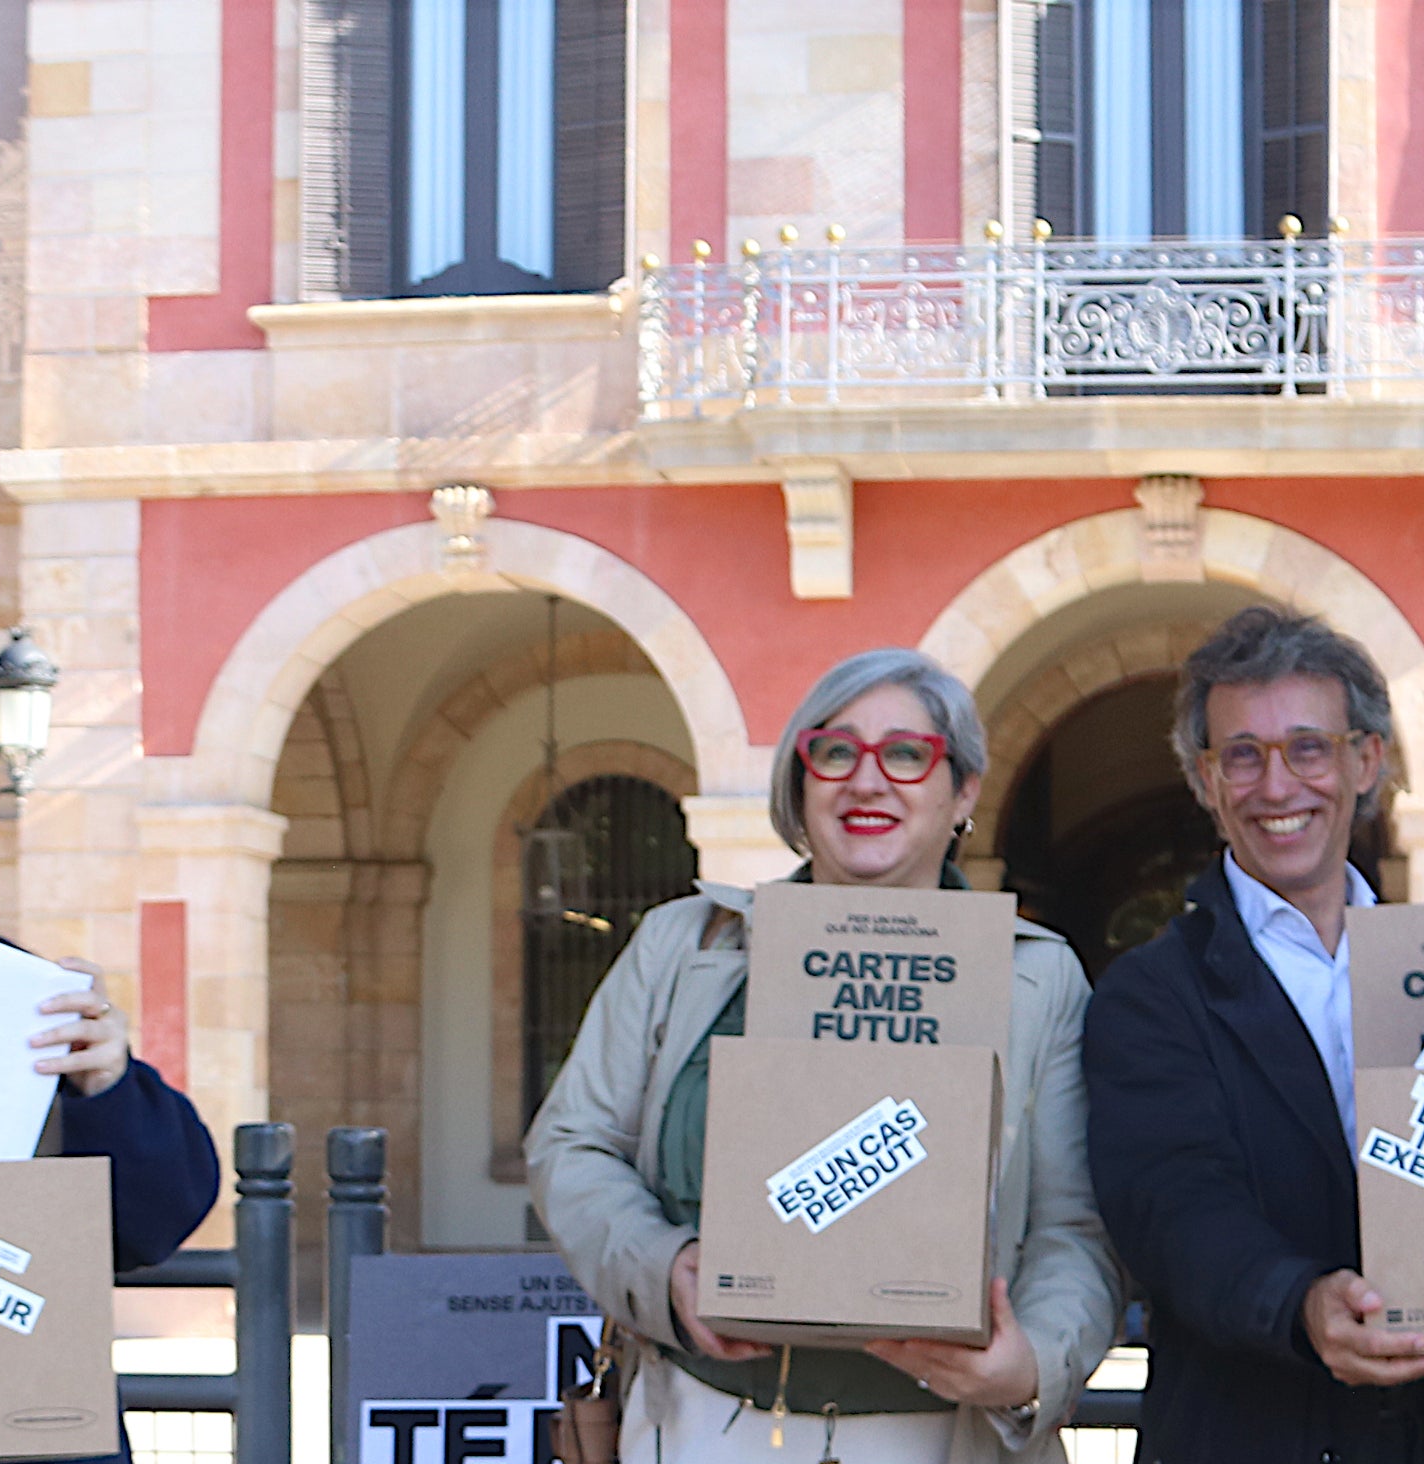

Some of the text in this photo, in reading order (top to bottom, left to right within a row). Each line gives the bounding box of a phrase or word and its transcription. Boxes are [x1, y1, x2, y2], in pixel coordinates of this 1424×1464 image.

[803, 951, 957, 983] CARTES
[833, 983, 923, 1012] AMB
[812, 1013, 939, 1045] FUTUR
[777, 1179, 817, 1215] ÉS
[814, 1148, 859, 1186] UN
[859, 1109, 917, 1156] CAS
[806, 1138, 913, 1225] PERDUT
[520, 1276, 550, 1292] UN
[448, 1295, 515, 1313] SENSE
[520, 1295, 589, 1313] AJUTS
